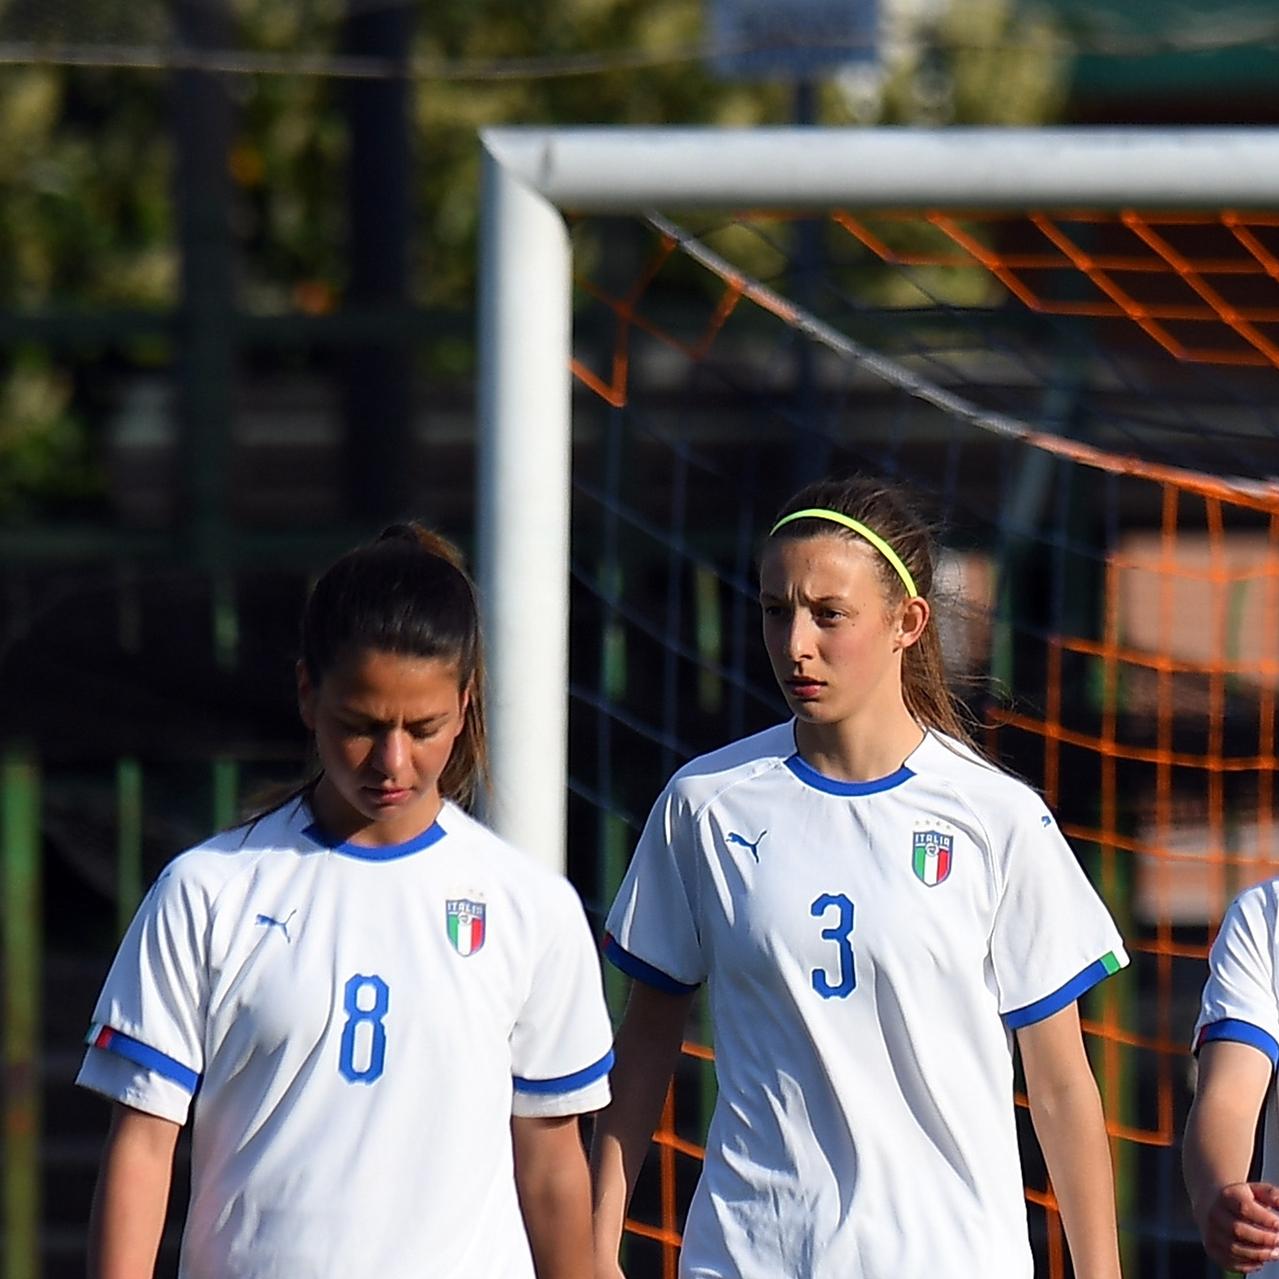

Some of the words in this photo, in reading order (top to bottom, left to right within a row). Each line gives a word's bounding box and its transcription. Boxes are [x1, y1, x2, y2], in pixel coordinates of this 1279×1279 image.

[915, 832, 950, 847] ITALIA
[811, 893, 857, 999] 3
[338, 973, 390, 1086] 8
